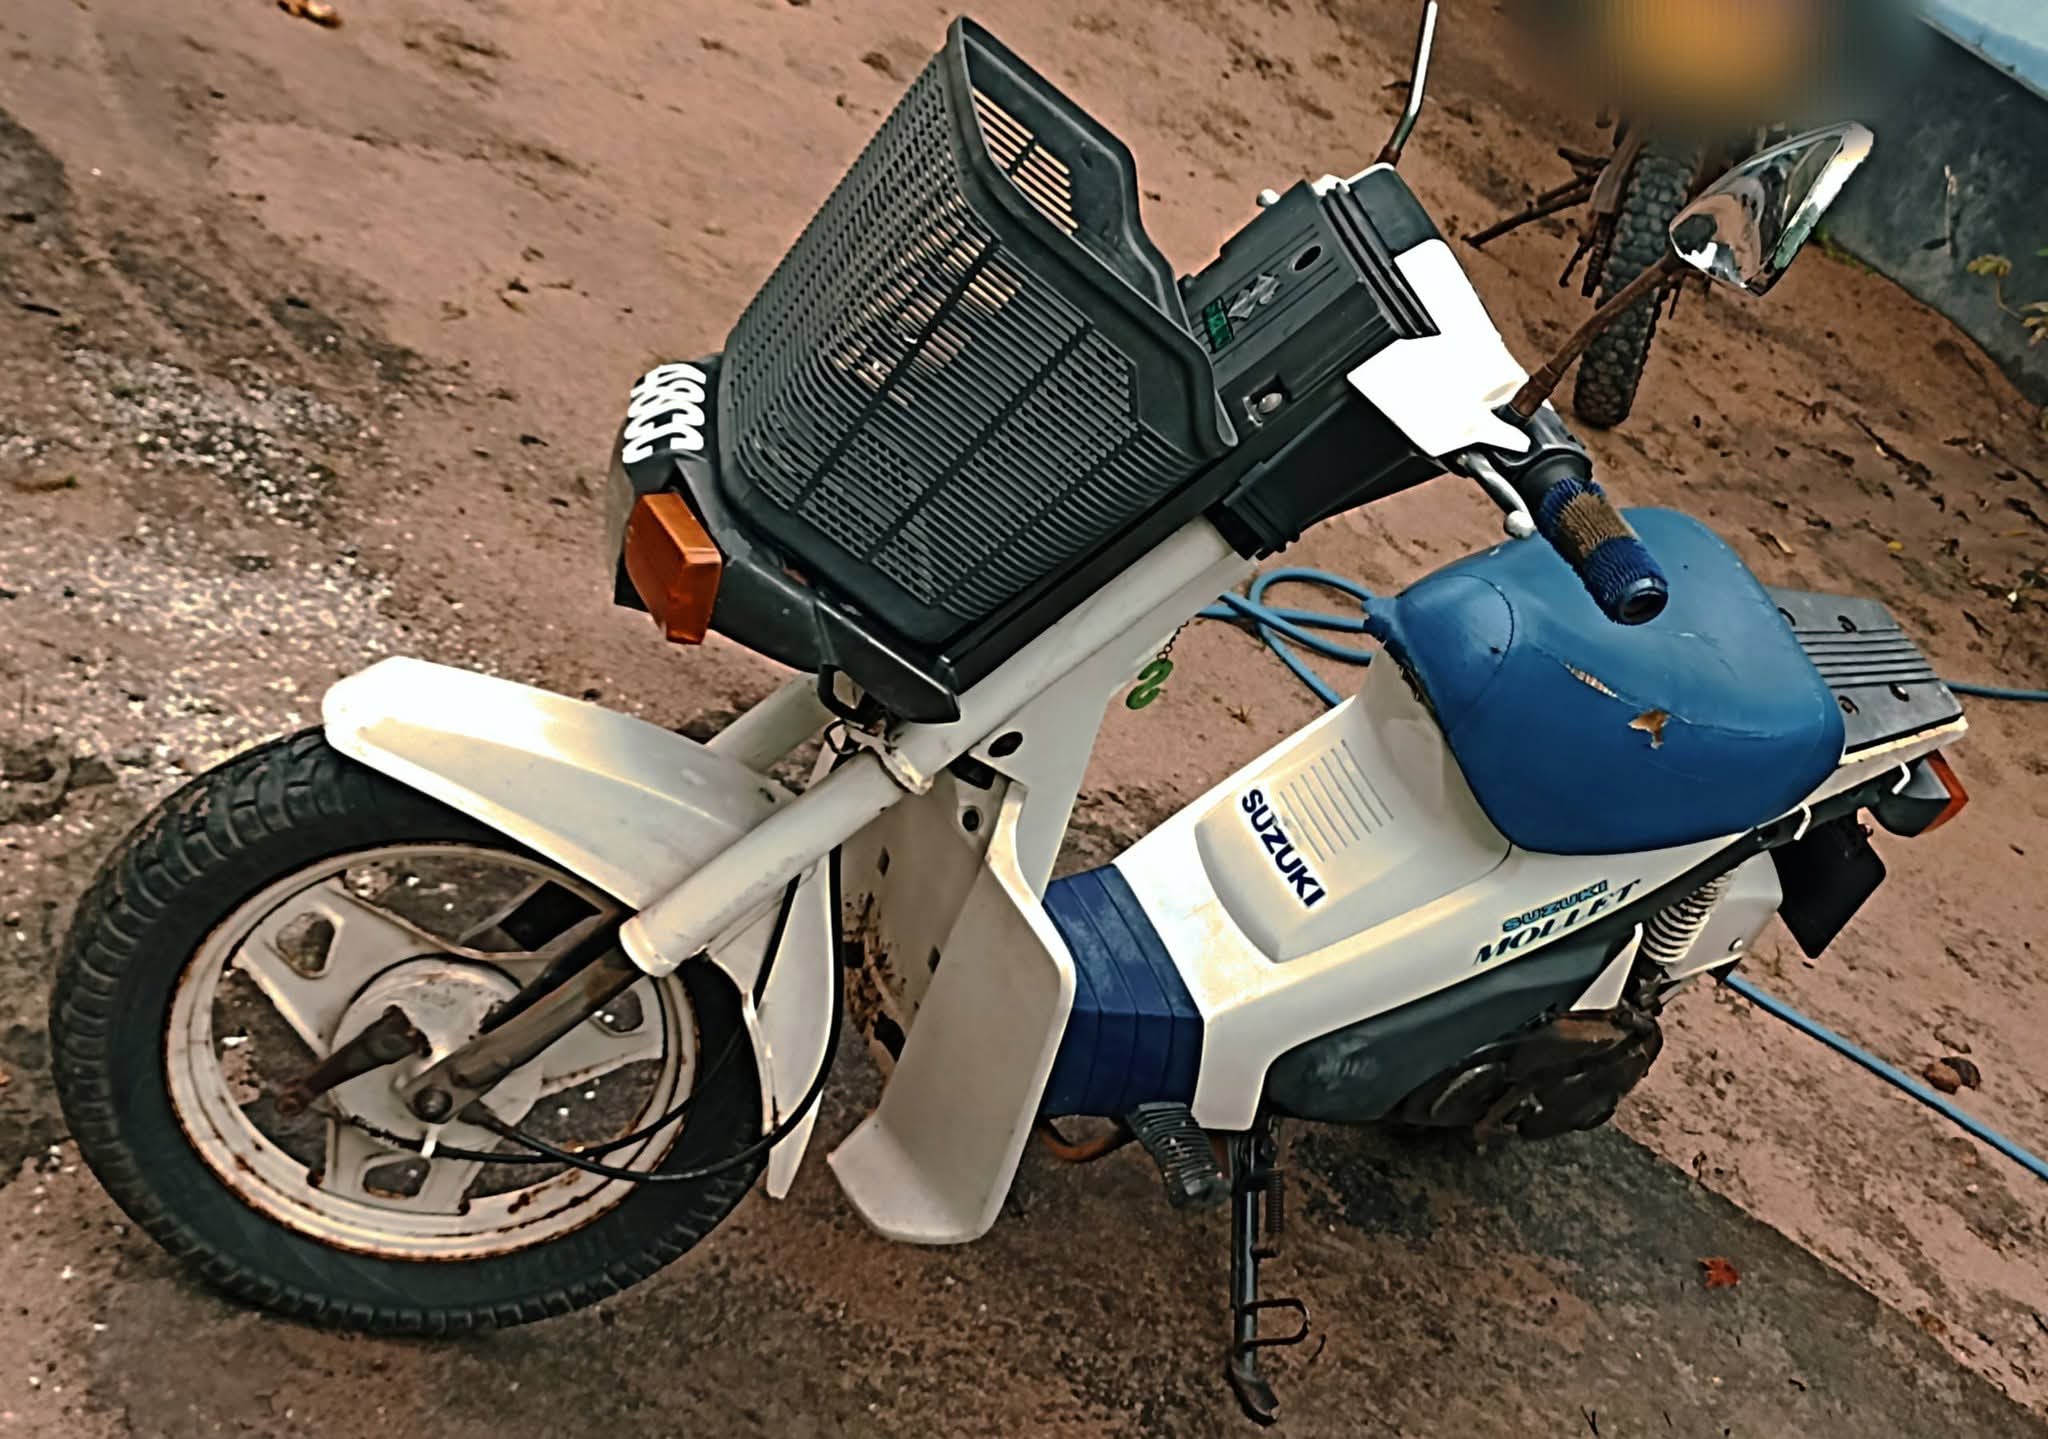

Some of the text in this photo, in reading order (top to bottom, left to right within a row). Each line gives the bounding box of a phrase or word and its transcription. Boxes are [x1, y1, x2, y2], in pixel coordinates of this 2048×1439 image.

[1242, 789, 1325, 907] SUZUKI
[1473, 879, 1641, 965] MOLLET
[1502, 879, 1608, 932] SUZUKI
